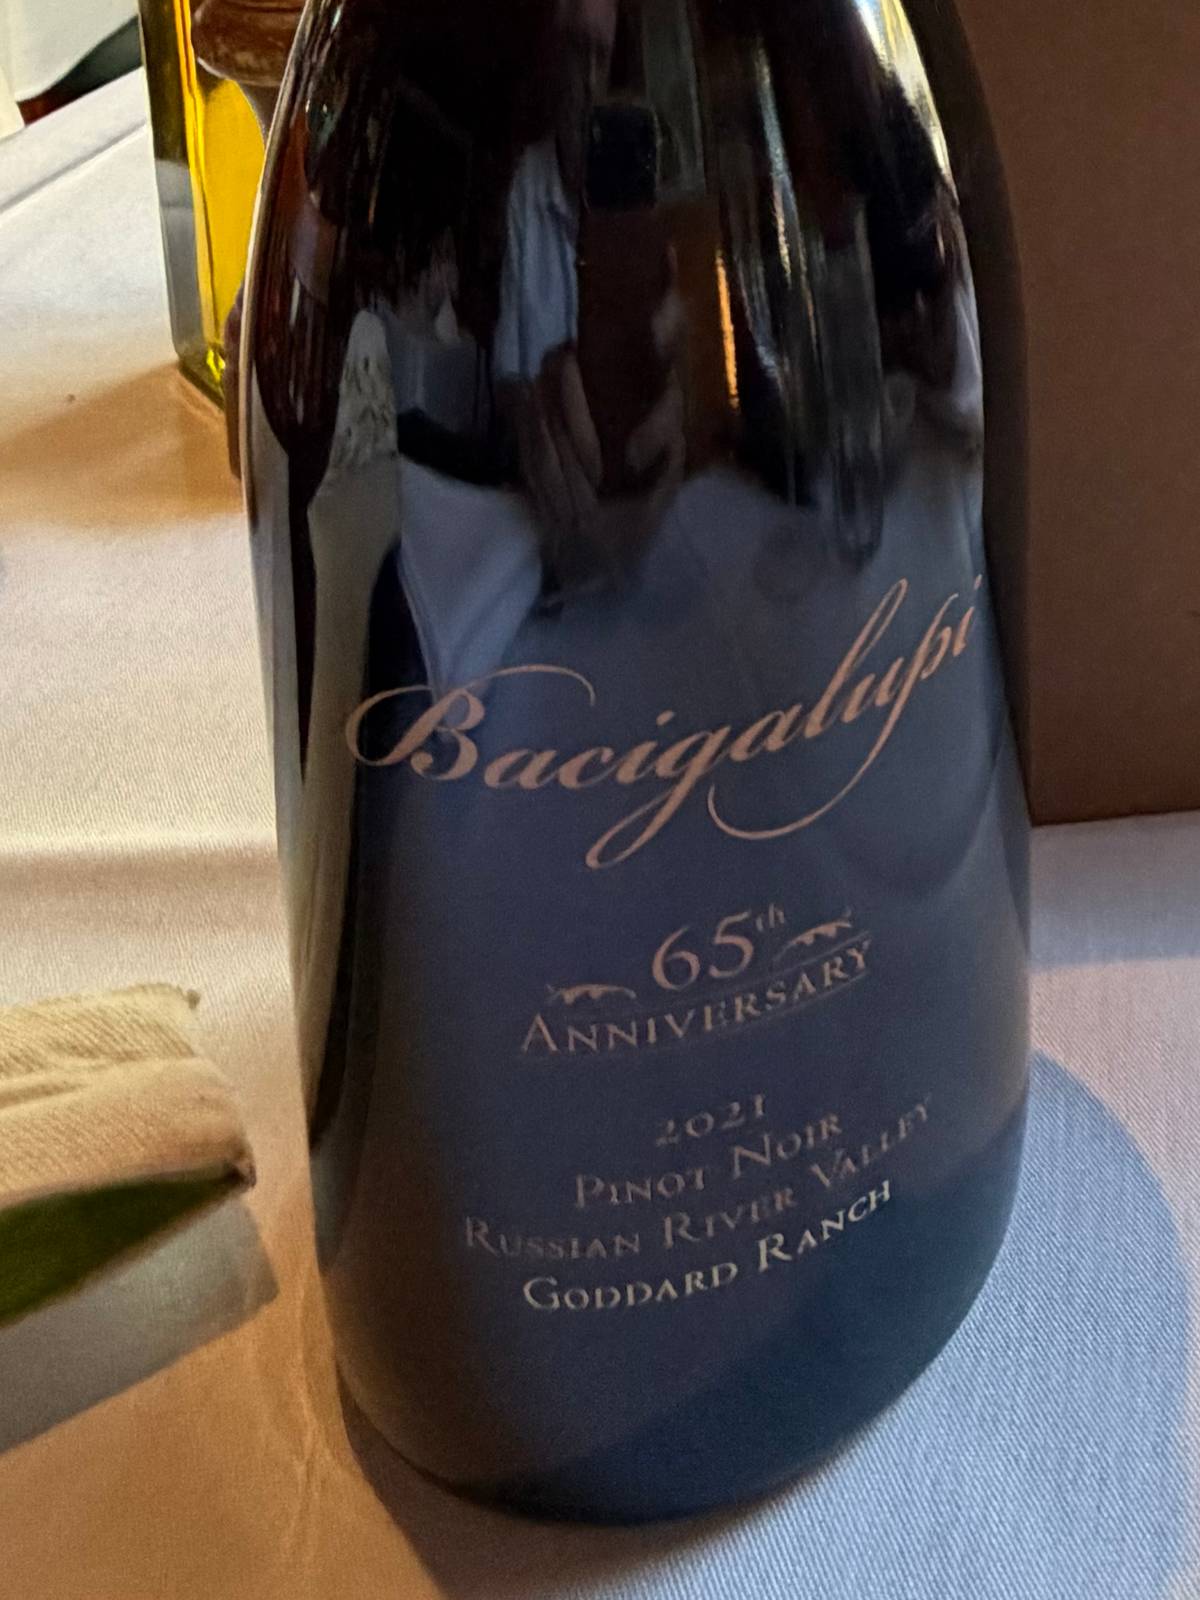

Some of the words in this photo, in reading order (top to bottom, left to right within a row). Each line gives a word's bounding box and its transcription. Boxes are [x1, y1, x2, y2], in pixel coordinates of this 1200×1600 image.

[345, 574, 983, 869] Bacigalupi
[523, 939, 872, 1051] ANNIVERSARY
[652, 903, 785, 991] 65th
[575, 1166, 708, 1208] PINOT
[732, 1112, 843, 1180] NOIR
[655, 1093, 766, 1147] 2021
[465, 1216, 641, 1260] RUSSIAN
[663, 1187, 798, 1250] RIVER
[809, 1094, 934, 1189] VALLEY
[523, 1262, 739, 1310] GODDARD
[757, 1179, 892, 1272] RANCH
